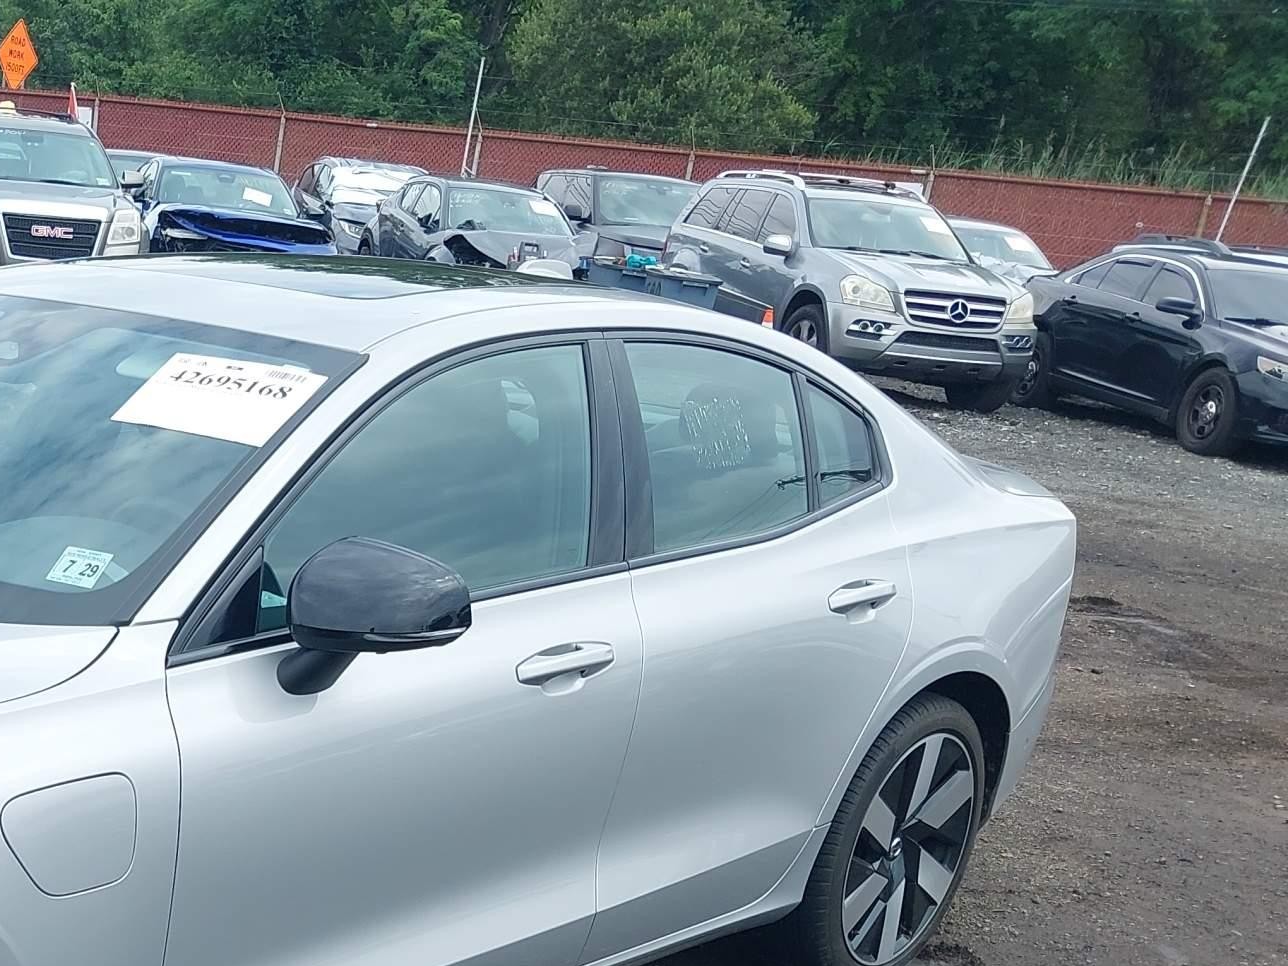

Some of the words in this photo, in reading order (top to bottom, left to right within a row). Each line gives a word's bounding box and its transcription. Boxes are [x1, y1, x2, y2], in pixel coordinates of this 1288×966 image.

[11, 35, 26, 48] ROAD
[8, 48, 24, 60] WORK
[31, 225, 74, 239] GMC
[169, 369, 294, 400] 42695168
[62, 559, 77, 573] 7
[78, 562, 100, 578] 29
